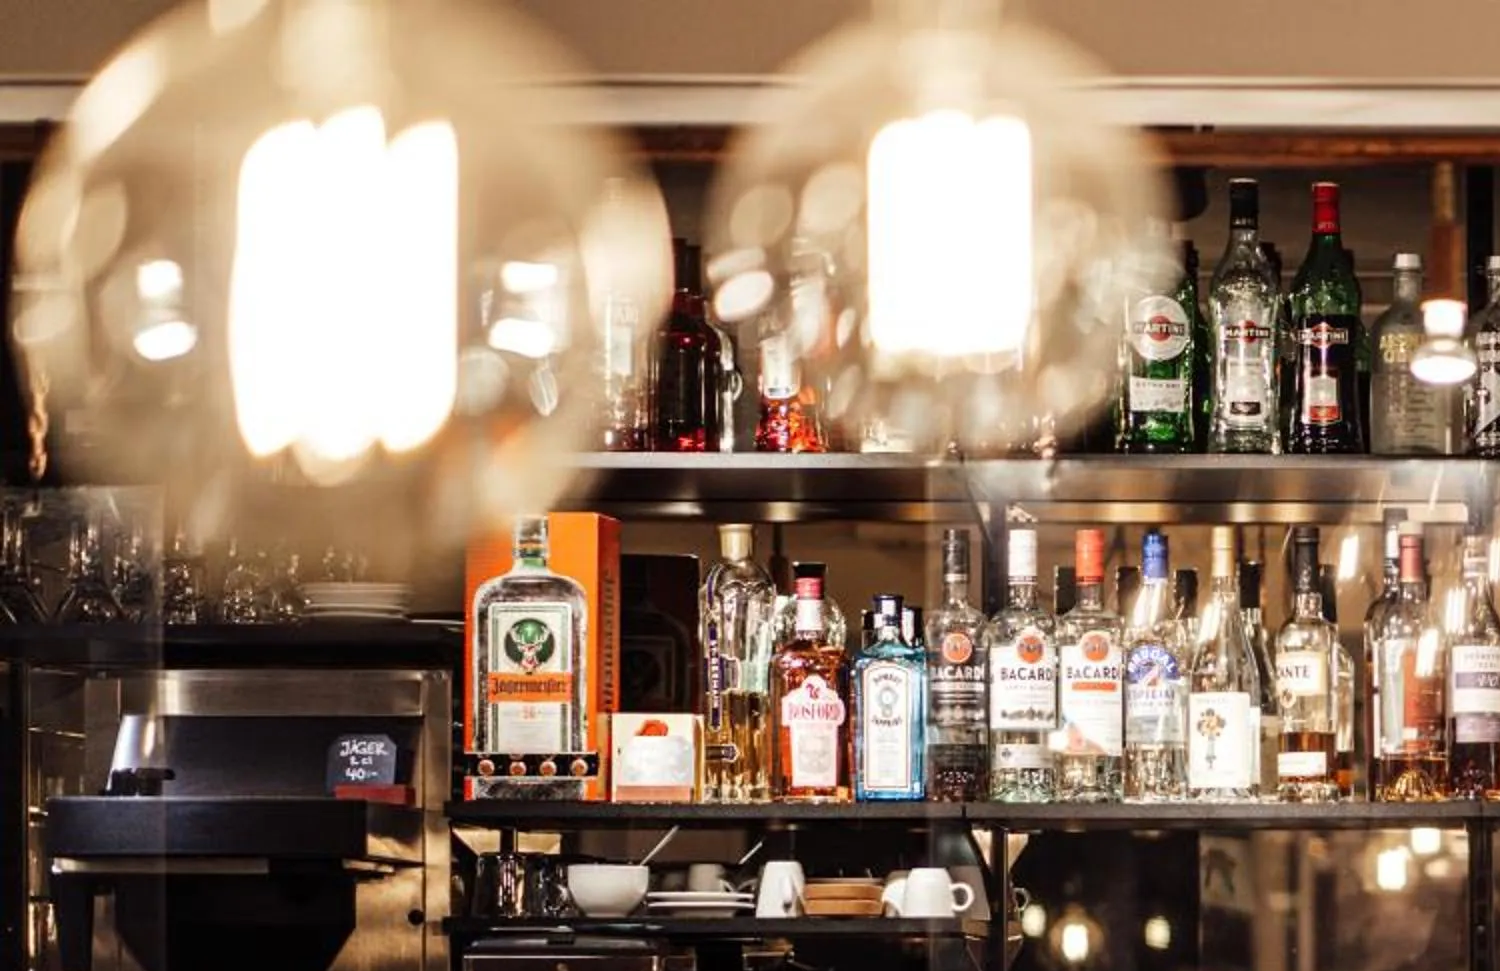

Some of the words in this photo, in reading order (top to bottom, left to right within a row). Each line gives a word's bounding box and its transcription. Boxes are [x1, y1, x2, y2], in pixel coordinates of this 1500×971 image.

[1133, 324, 1185, 336] MARTINI
[1226, 328, 1270, 338] MARTINI
[1301, 330, 1346, 343] MARTINI
[1128, 646, 1176, 673] BRUGAL
[339, 739, 389, 757] JÄGER
